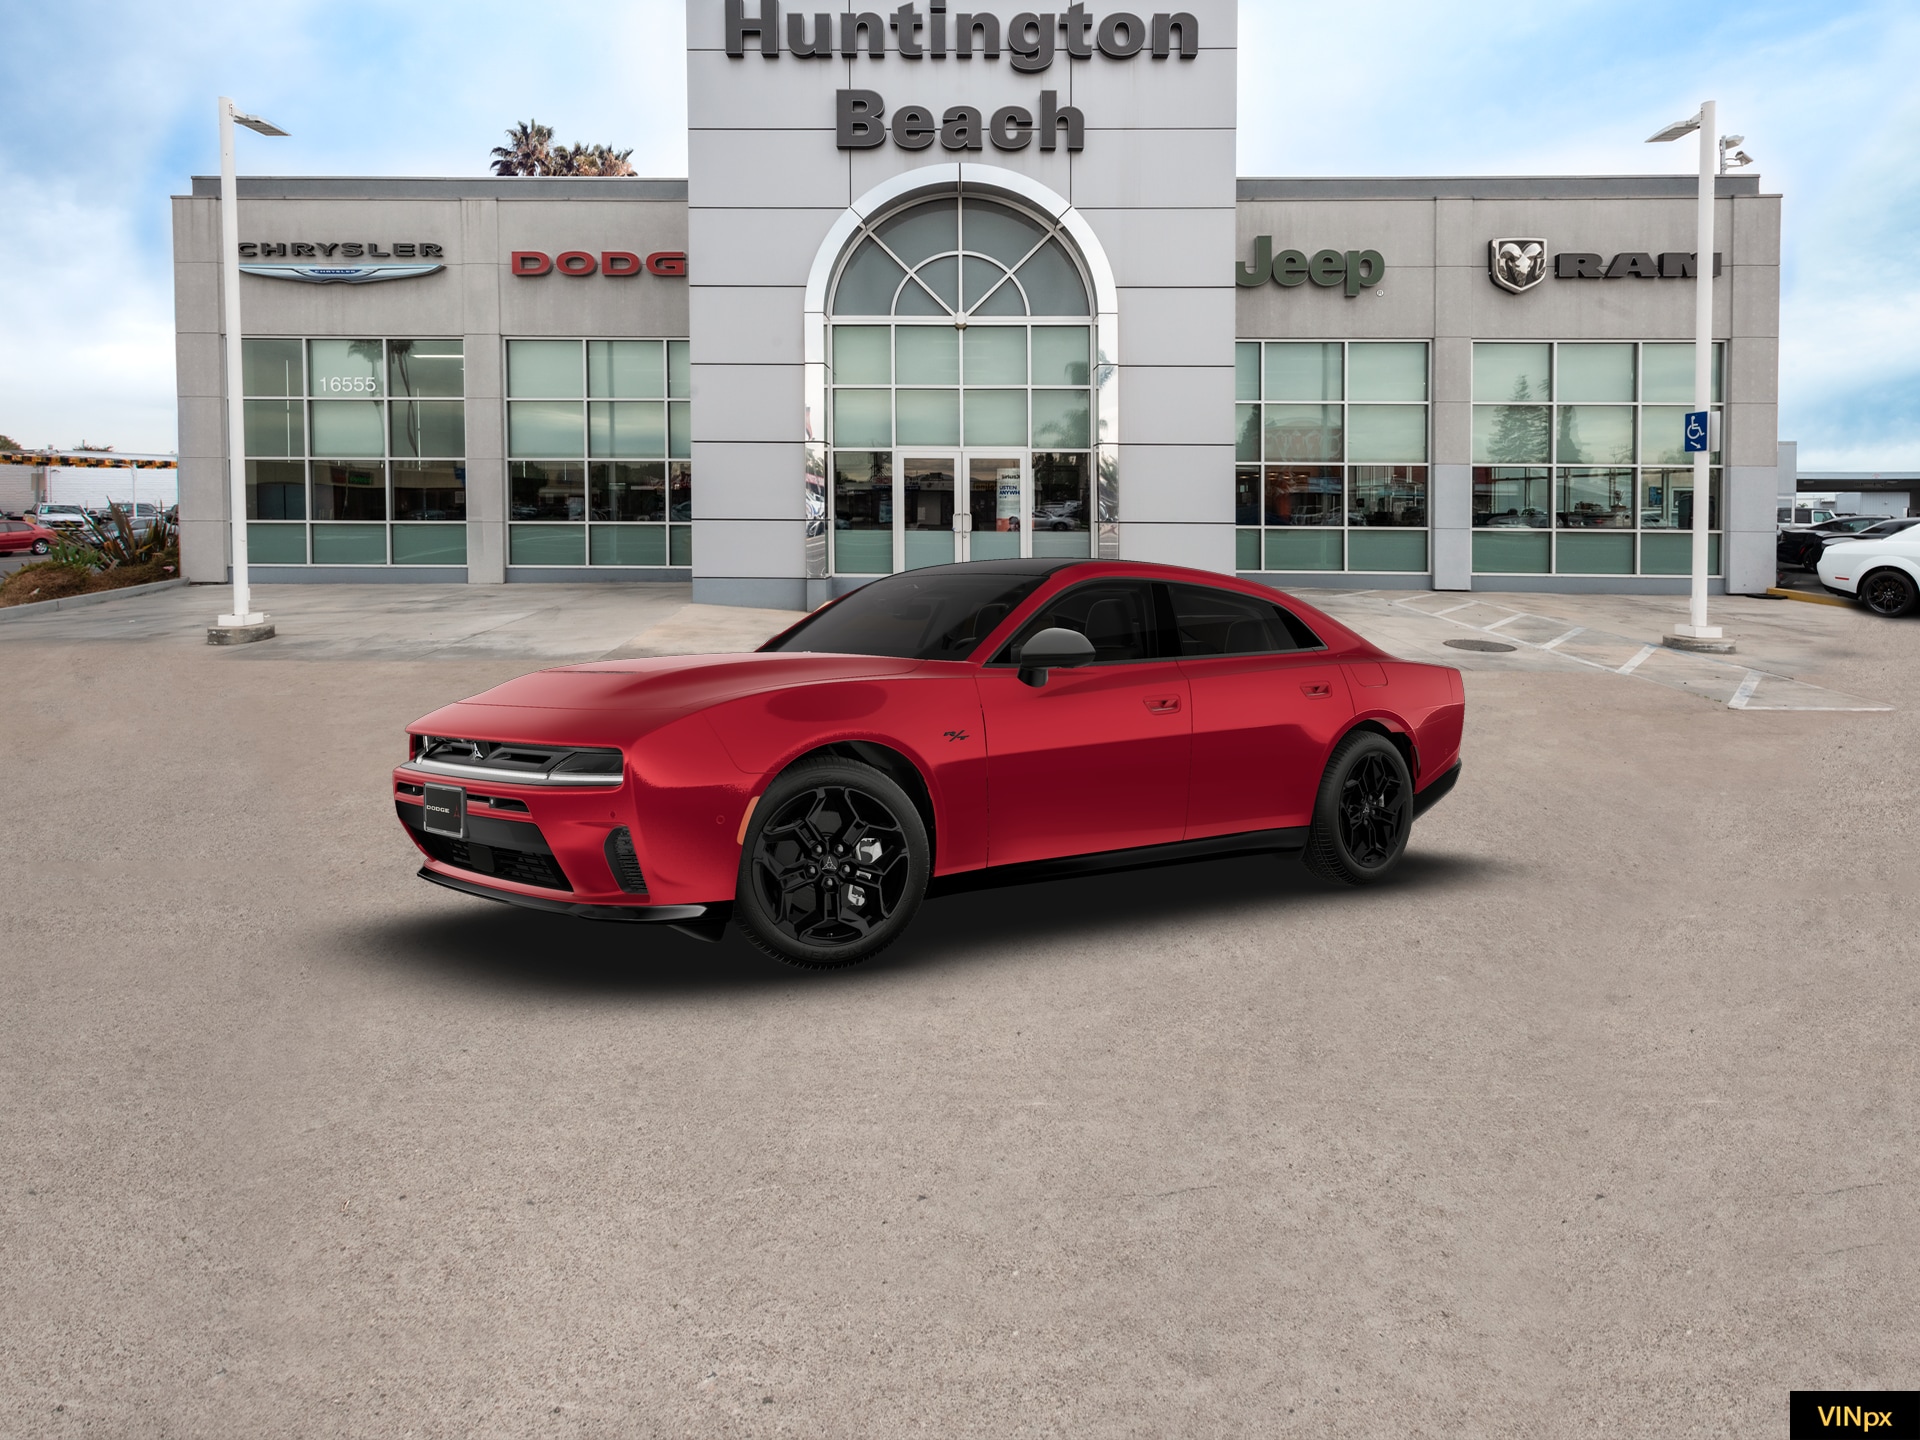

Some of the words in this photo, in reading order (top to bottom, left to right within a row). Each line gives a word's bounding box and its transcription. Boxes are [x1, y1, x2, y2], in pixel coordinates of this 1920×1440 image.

[724, 0, 1199, 74] Huntington
[835, 88, 1085, 152] Beach
[238, 241, 443, 258] CHRYSLER
[1235, 235, 1386, 297] Jeep
[1554, 252, 1722, 279] RAM
[319, 376, 376, 392] 16555
[426, 804, 450, 813] DODGE
